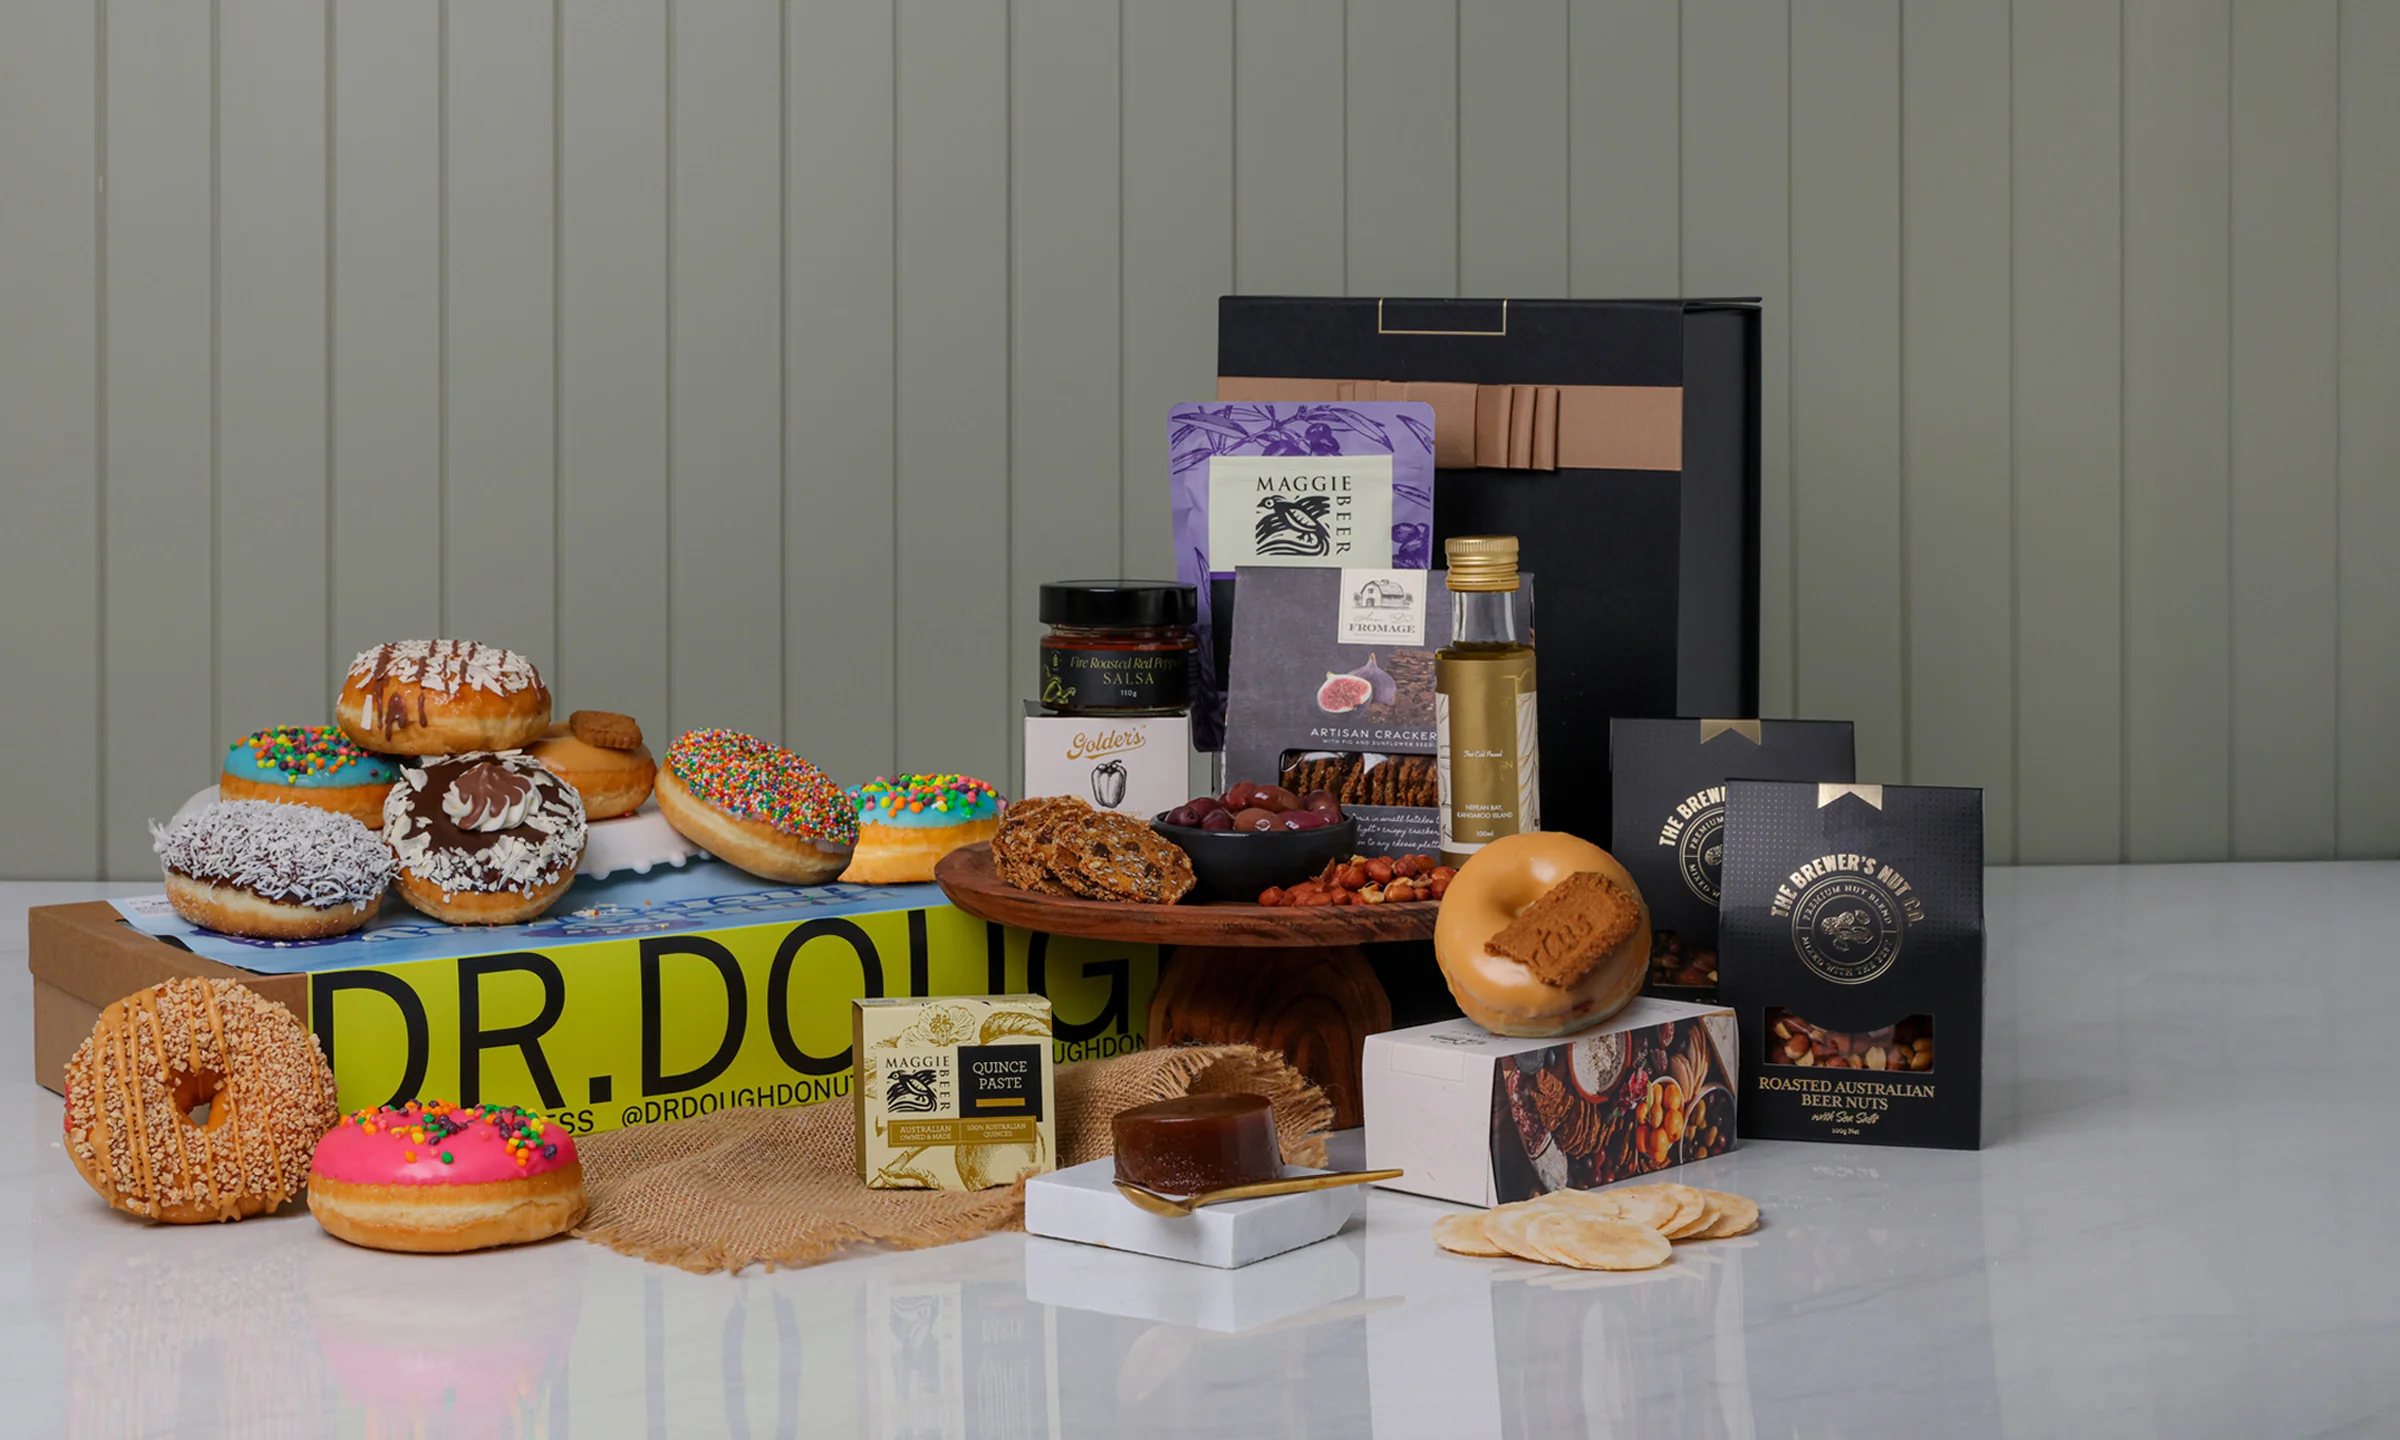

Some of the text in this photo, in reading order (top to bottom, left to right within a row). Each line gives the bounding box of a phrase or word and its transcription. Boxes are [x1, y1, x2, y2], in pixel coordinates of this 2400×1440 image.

[1256, 475, 1352, 492] MAGGIE
[1335, 495, 1352, 556] BEER
[1348, 623, 1416, 634] FROMAGE
[1070, 656, 1089, 669] Fire
[1090, 656, 1131, 669] Roasted
[1133, 656, 1153, 669] Red
[1103, 672, 1155, 685] SALSA
[1120, 689, 1138, 698] 110g
[1310, 727, 1369, 739] ARTISAN
[1066, 728, 1147, 760] Golder's
[1372, 740, 1414, 748] SUNFLOWER
[1456, 811, 1513, 819] KANGAROO ISLAND
[1658, 815, 1684, 847] THE
[1770, 884, 1798, 917] THE
[1789, 853, 1877, 889] BREWER'S
[1877, 864, 1912, 897] NUT
[1802, 884, 1893, 925] PREMIUM NUT BLEND
[1801, 935, 1825, 967] MIXED
[885, 1055, 950, 1069] MAGGIE
[972, 1060, 1028, 1075] QUINCE
[939, 1069, 951, 1111] BEER
[978, 1076, 1023, 1090] PASTE
[1758, 1076, 1936, 1098] ROASTED AUSTRALIAN
[621, 1073, 855, 1129] @DRDOUGHDONU
[1801, 1093, 1889, 1111] BEER NUTS
[1811, 1110, 1880, 1125] with Sea Salt
[900, 1124, 952, 1134] AUSTRALIAN
[966, 1123, 1027, 1132] 100% AUSTRALIAN
[982, 1130, 1013, 1138] QUINCES
[899, 1133, 926, 1141] OWNED
